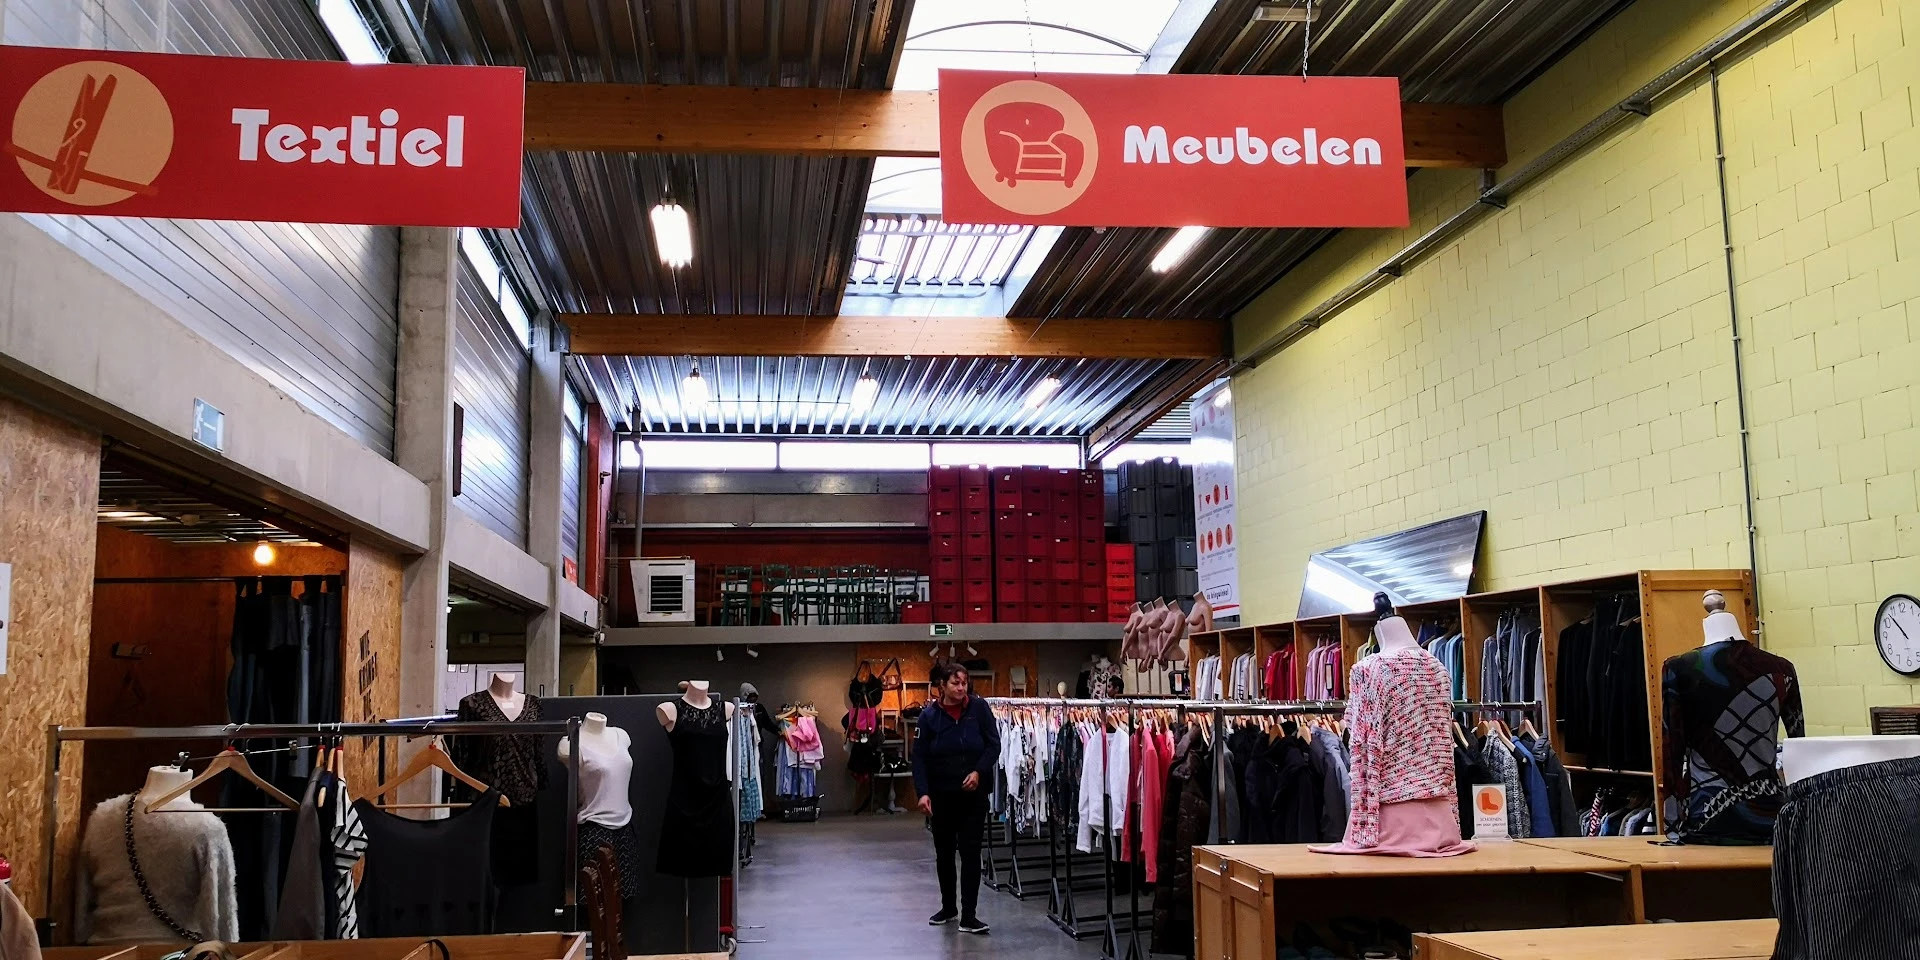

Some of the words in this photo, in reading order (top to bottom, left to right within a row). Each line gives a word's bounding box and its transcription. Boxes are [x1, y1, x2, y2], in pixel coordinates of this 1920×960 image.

[231, 108, 465, 167] Textiel
[1123, 125, 1382, 165] Meubelen
[1890, 605, 1896, 616] 11
[1898, 602, 1906, 613] 12
[1910, 604, 1914, 615] 1
[1883, 617, 1891, 628] 10
[1883, 630, 1888, 640] 9
[1887, 643, 1893, 655] 8
[1896, 654, 1900, 664] 7
[1906, 656, 1912, 666] 6
